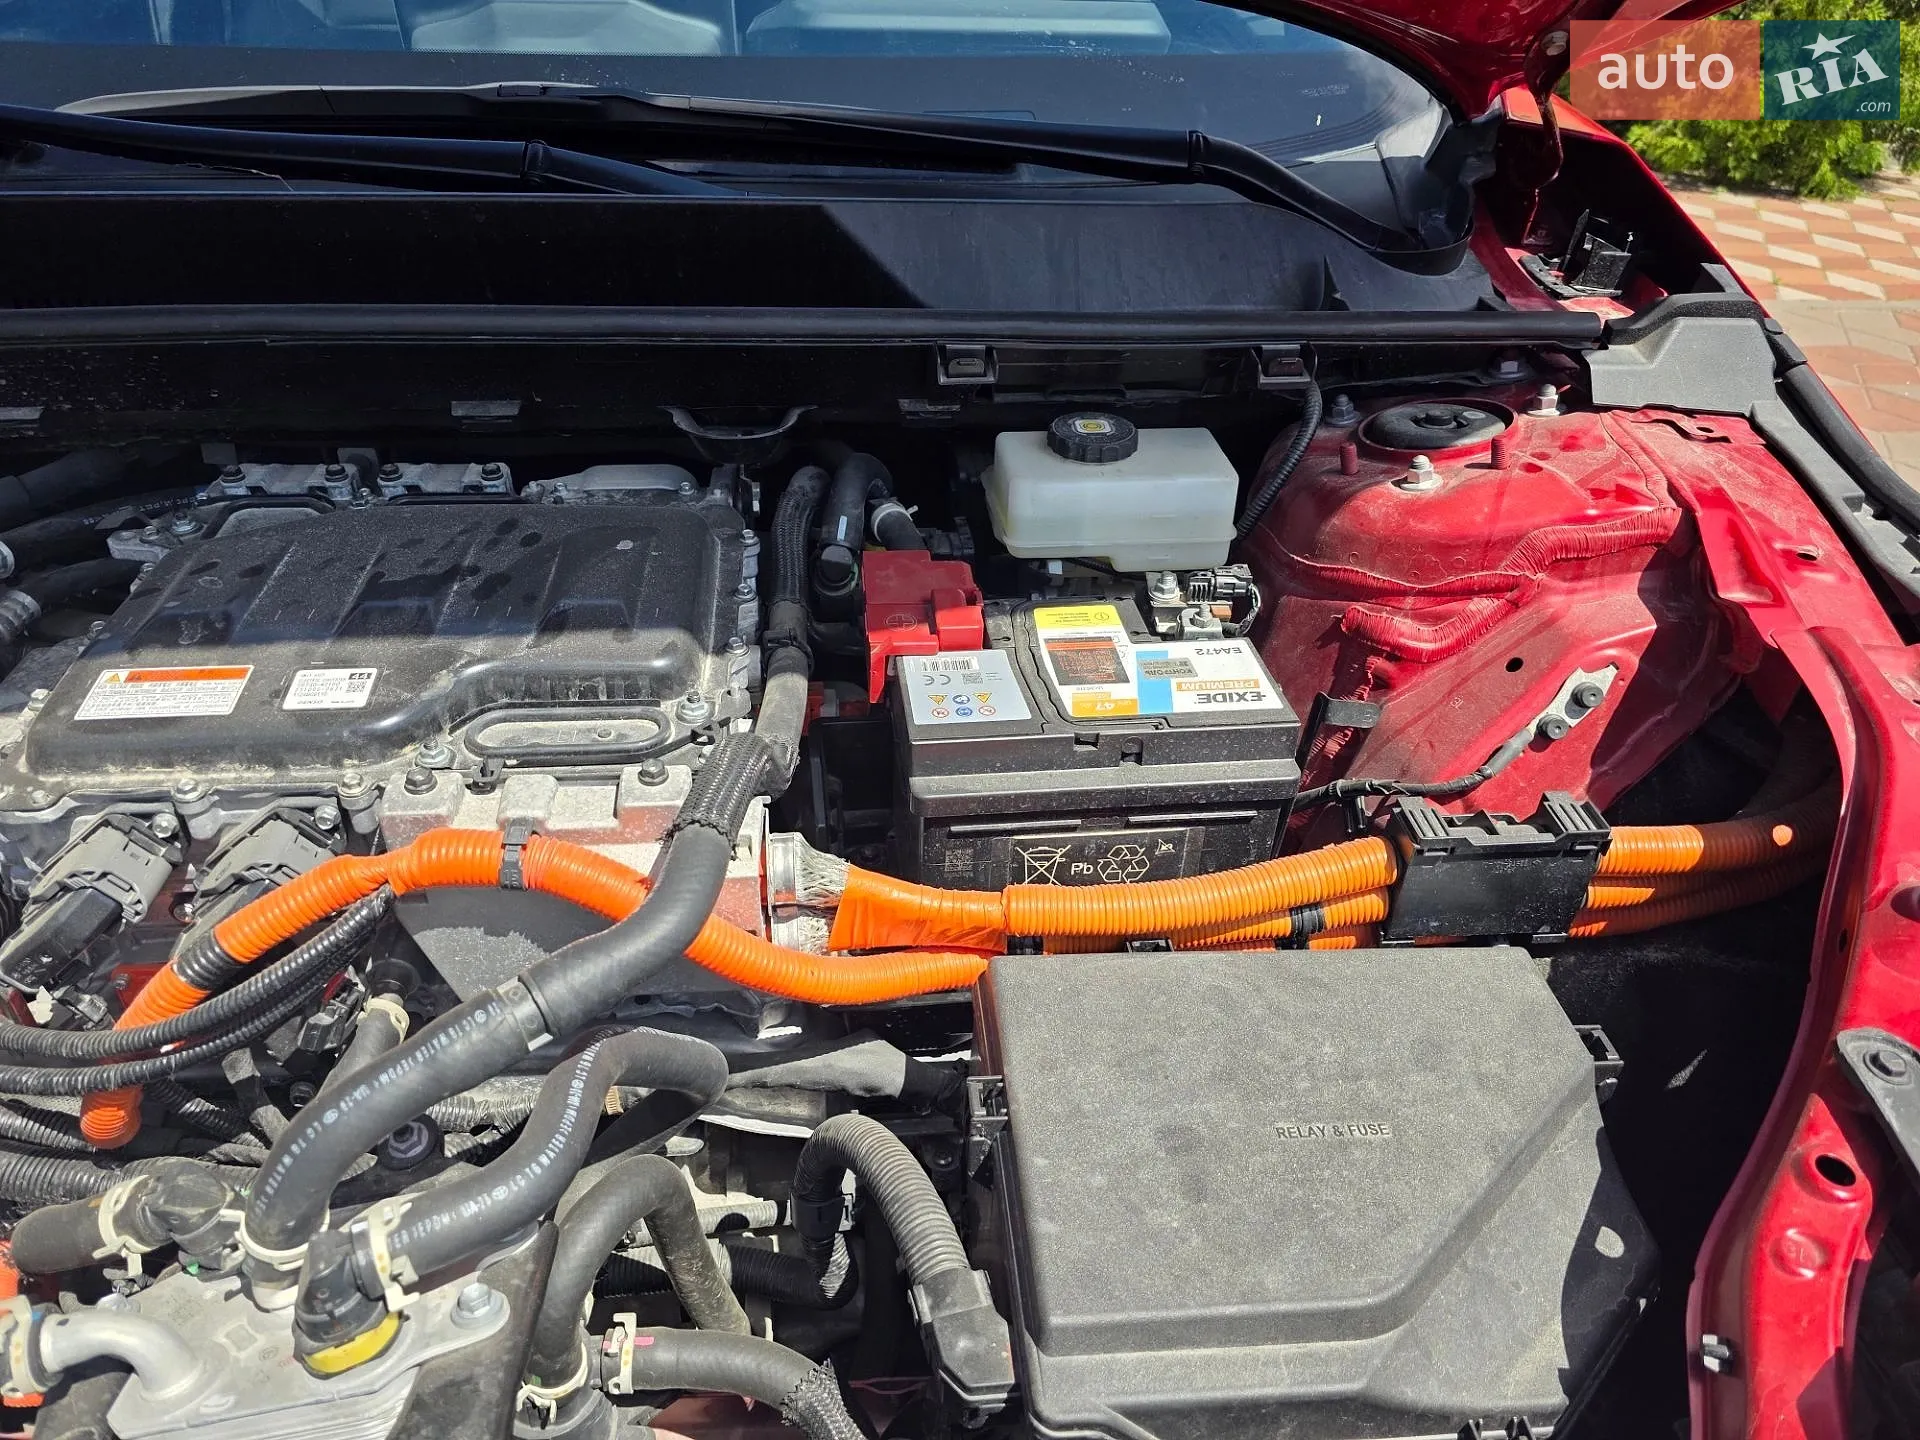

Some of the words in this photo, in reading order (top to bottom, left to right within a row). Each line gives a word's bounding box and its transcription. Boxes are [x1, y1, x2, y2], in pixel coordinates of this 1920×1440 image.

[1193, 647, 1243, 656] EA472
[1181, 679, 1256, 690] PREMIUM
[1196, 691, 1267, 705] EXIDE
[1095, 701, 1116, 711] 47
[1070, 862, 1094, 875] Pb
[416, 1032, 449, 1063] WATER
[1275, 1125, 1326, 1139] RELAY
[1332, 1124, 1345, 1137] &
[1347, 1123, 1390, 1137] FUSE
[538, 1134, 567, 1167] WATER
[265, 1154, 294, 1194] WATER
